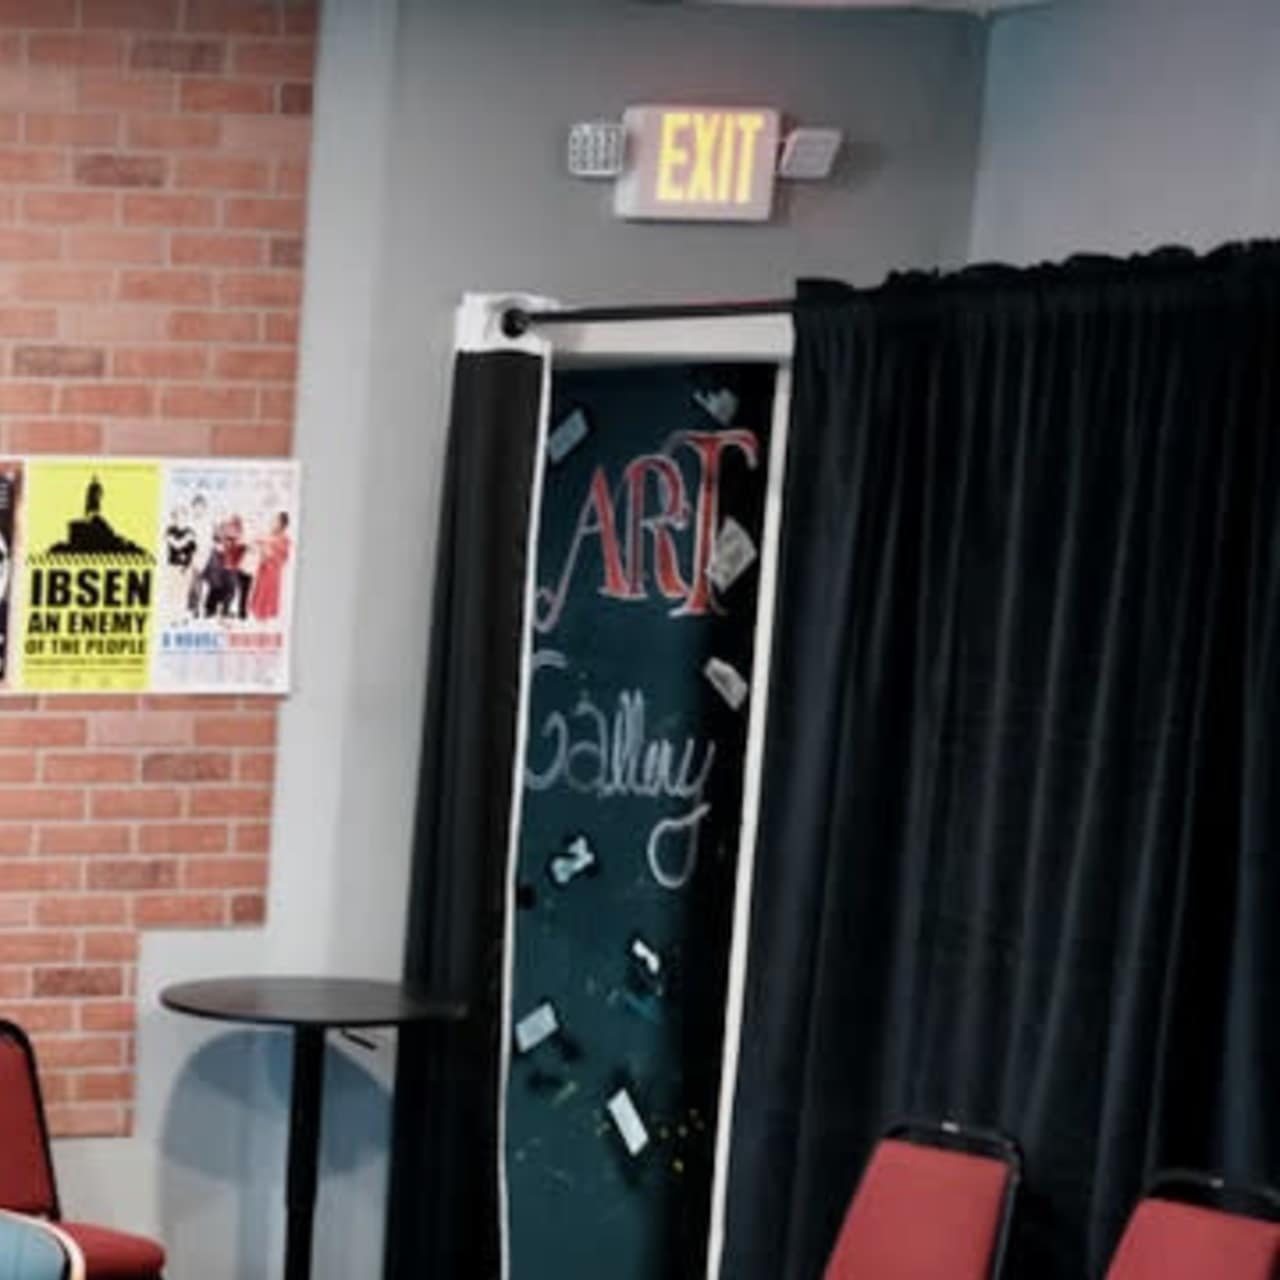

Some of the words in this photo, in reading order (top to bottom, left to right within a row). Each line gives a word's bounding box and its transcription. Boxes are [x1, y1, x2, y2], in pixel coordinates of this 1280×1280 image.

[657, 113, 763, 204] EXIT
[532, 429, 758, 632] ART
[30, 569, 152, 608] IBSEN
[27, 611, 61, 634] AN
[67, 611, 148, 634] ENEMY
[24, 638, 44, 655] OF
[51, 638, 80, 655] THE
[85, 638, 146, 655] PEOPLE
